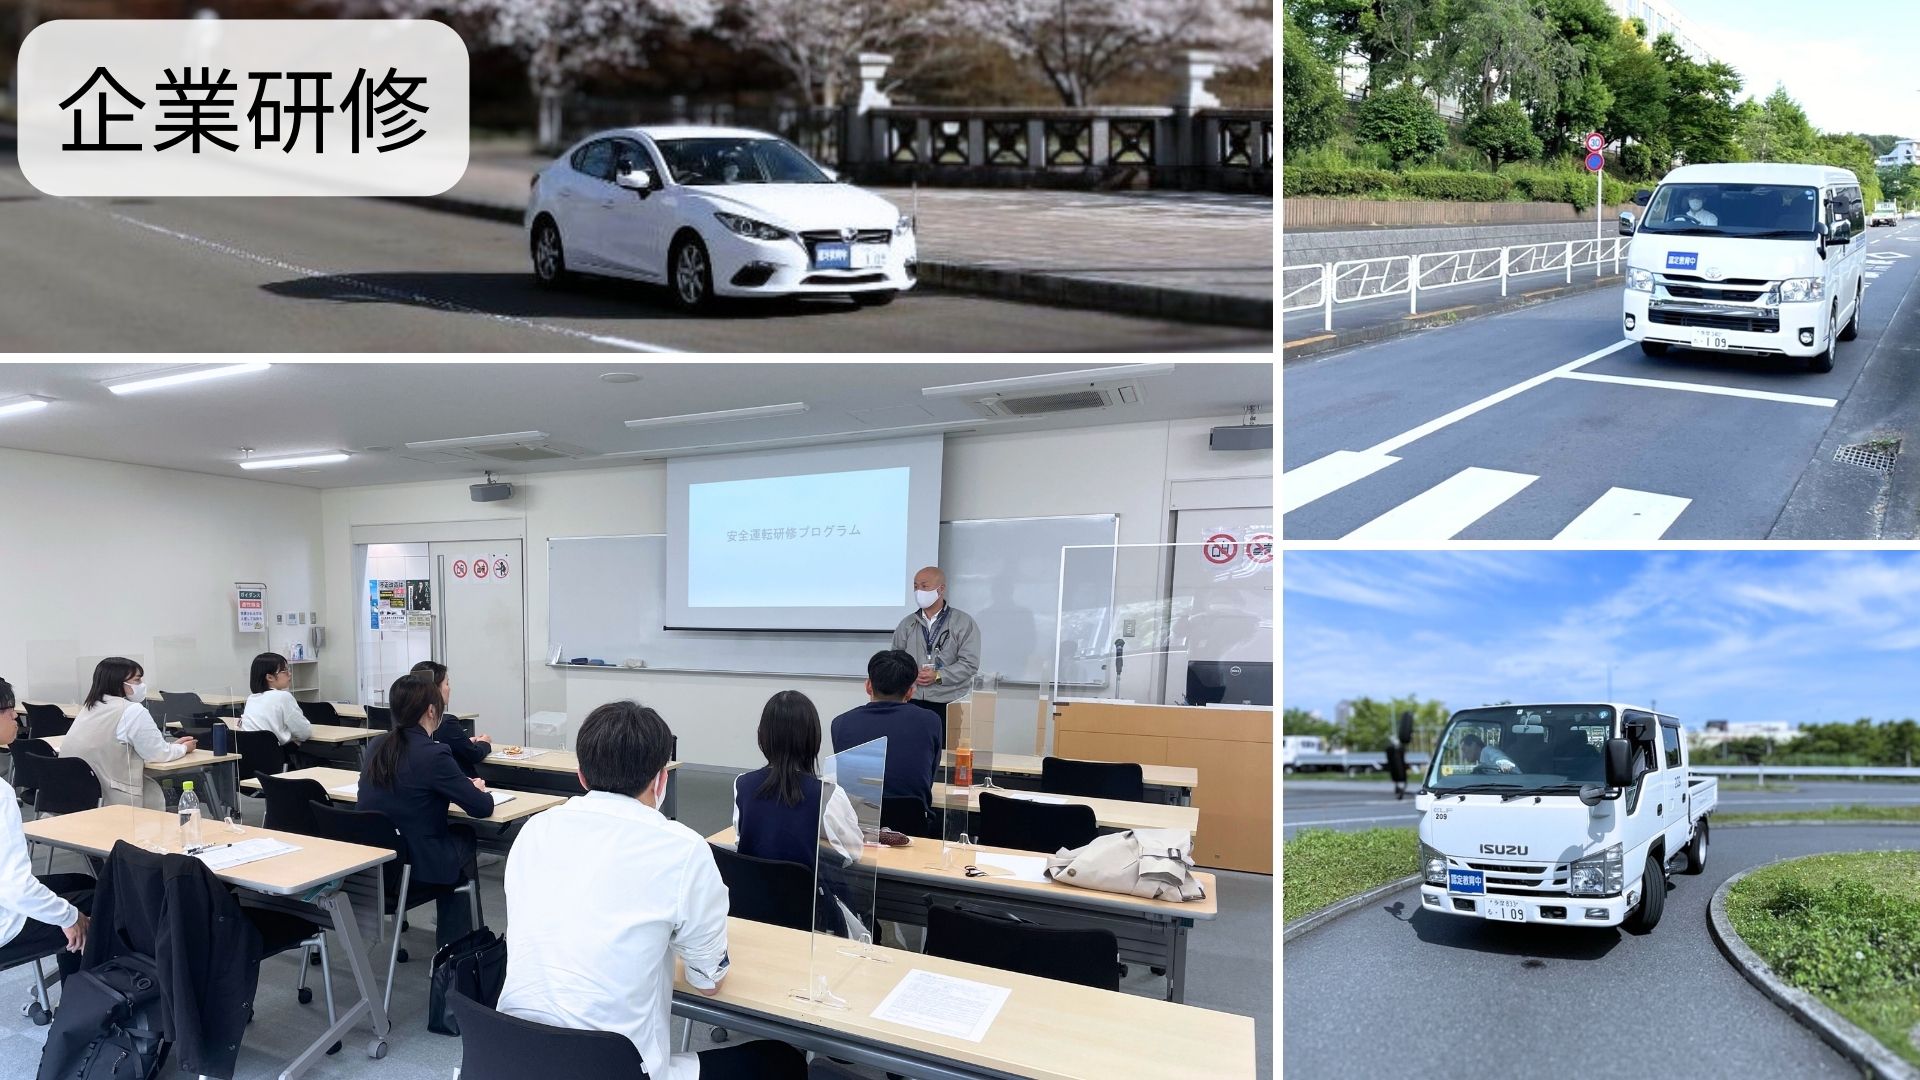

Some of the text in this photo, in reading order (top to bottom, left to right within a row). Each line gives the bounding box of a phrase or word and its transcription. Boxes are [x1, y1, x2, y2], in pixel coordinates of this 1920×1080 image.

[1590, 138, 1600, 147] 30
[726, 523, 861, 543] 安全運転研修プログラム
[1480, 843, 1528, 856] ISUZU
